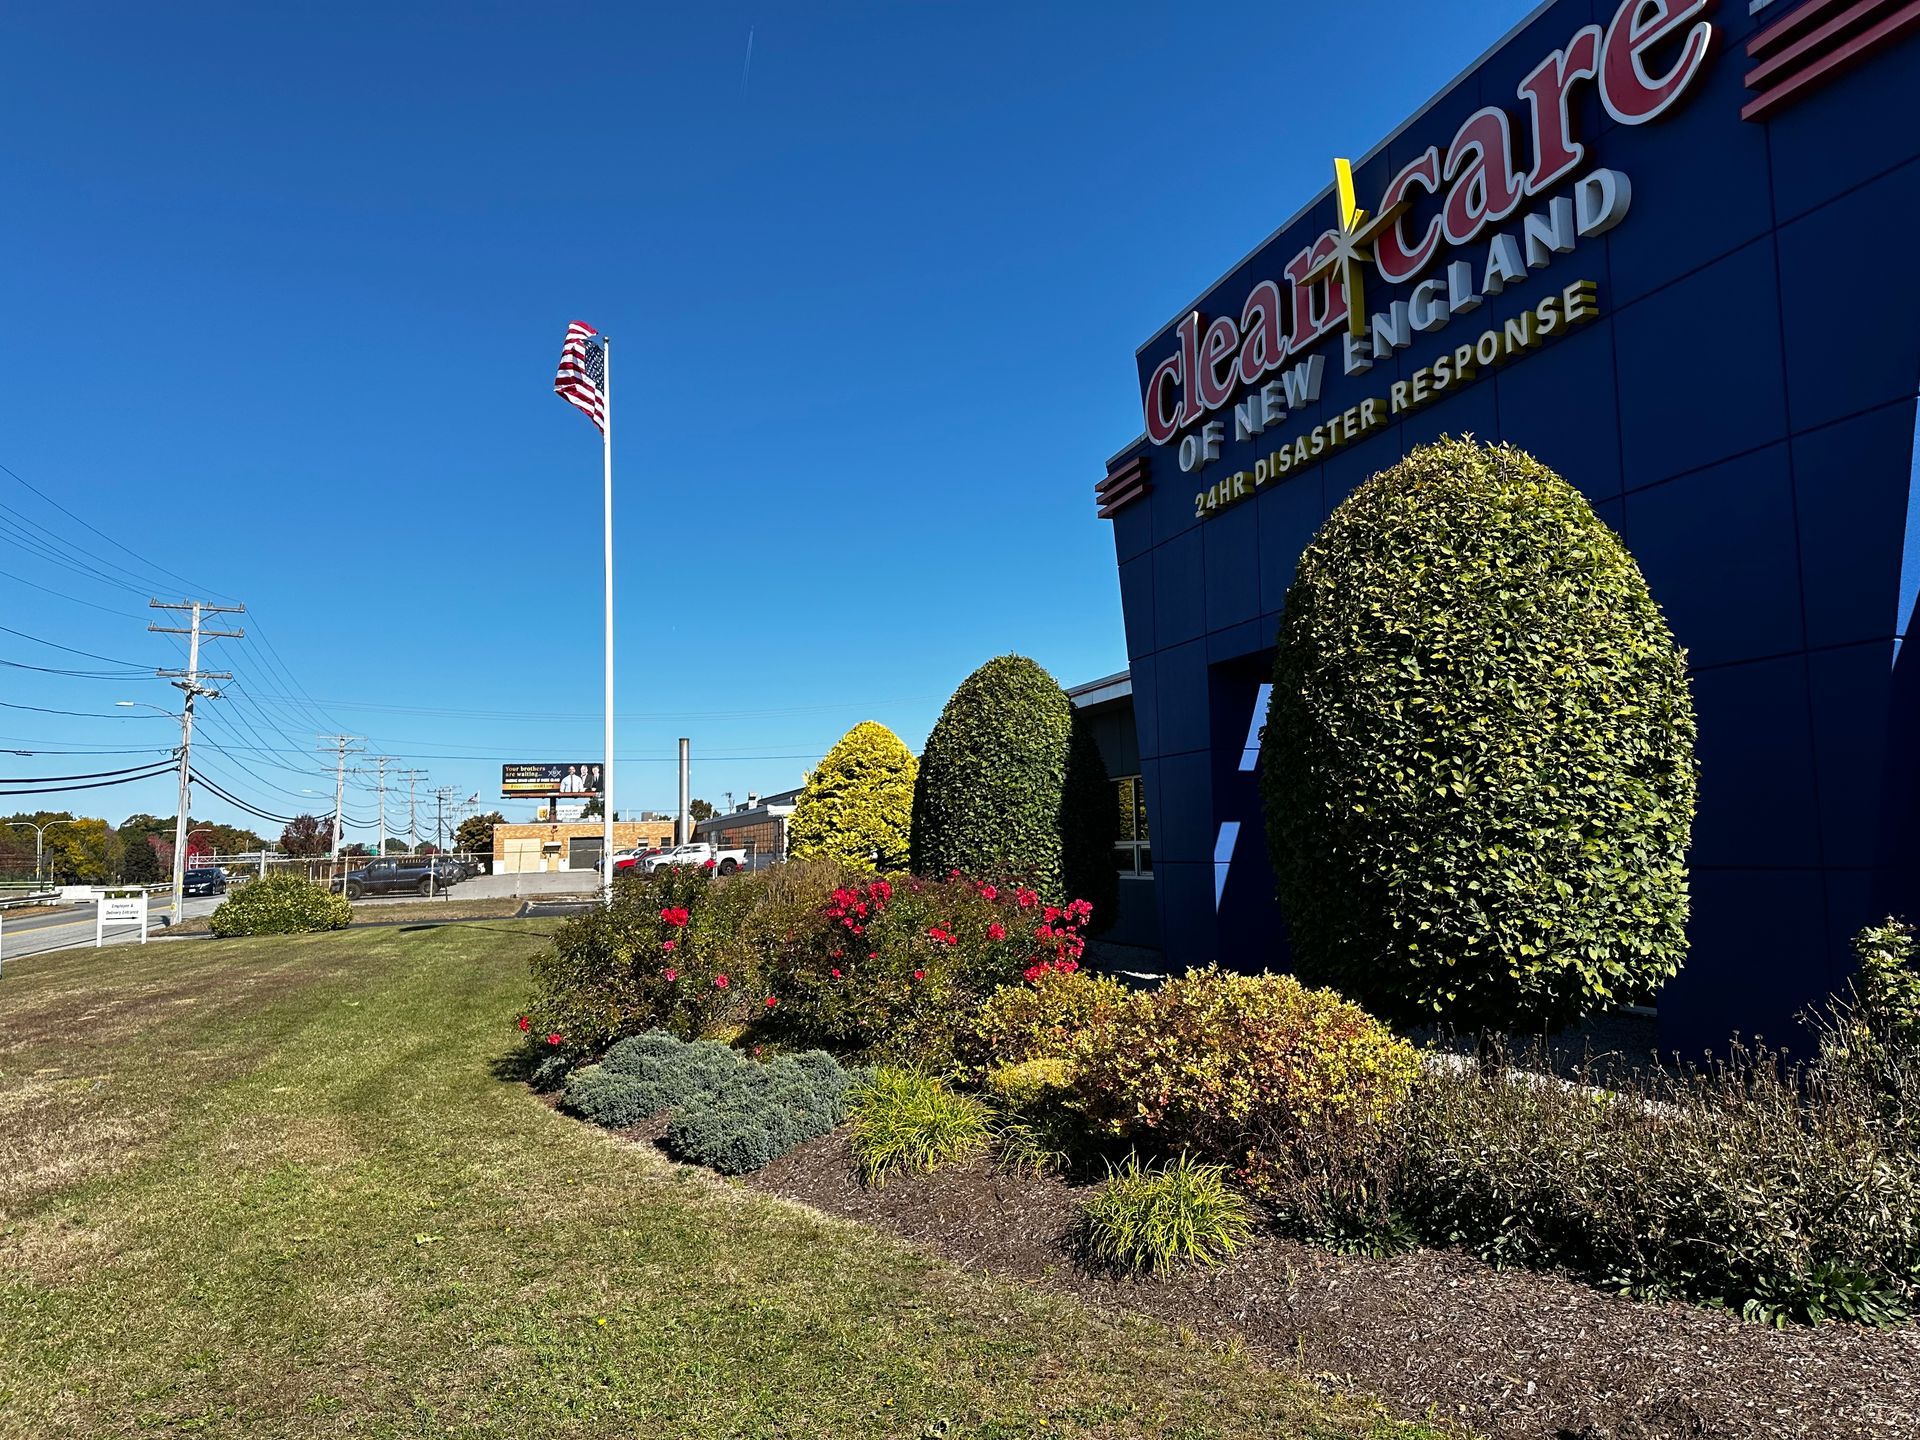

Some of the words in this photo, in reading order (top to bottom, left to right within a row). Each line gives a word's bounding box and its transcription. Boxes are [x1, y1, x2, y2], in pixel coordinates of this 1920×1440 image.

[1145, 229, 1351, 446] clean
[1376, 0, 1712, 283] care
[1178, 420, 1225, 473] OF
[1234, 354, 1325, 442] NEW
[1343, 167, 1632, 376] ENGLAND
[1194, 469, 1256, 519] 24HR
[1254, 397, 1388, 487] DISASTER
[1390, 280, 1600, 415] RESPONSE
